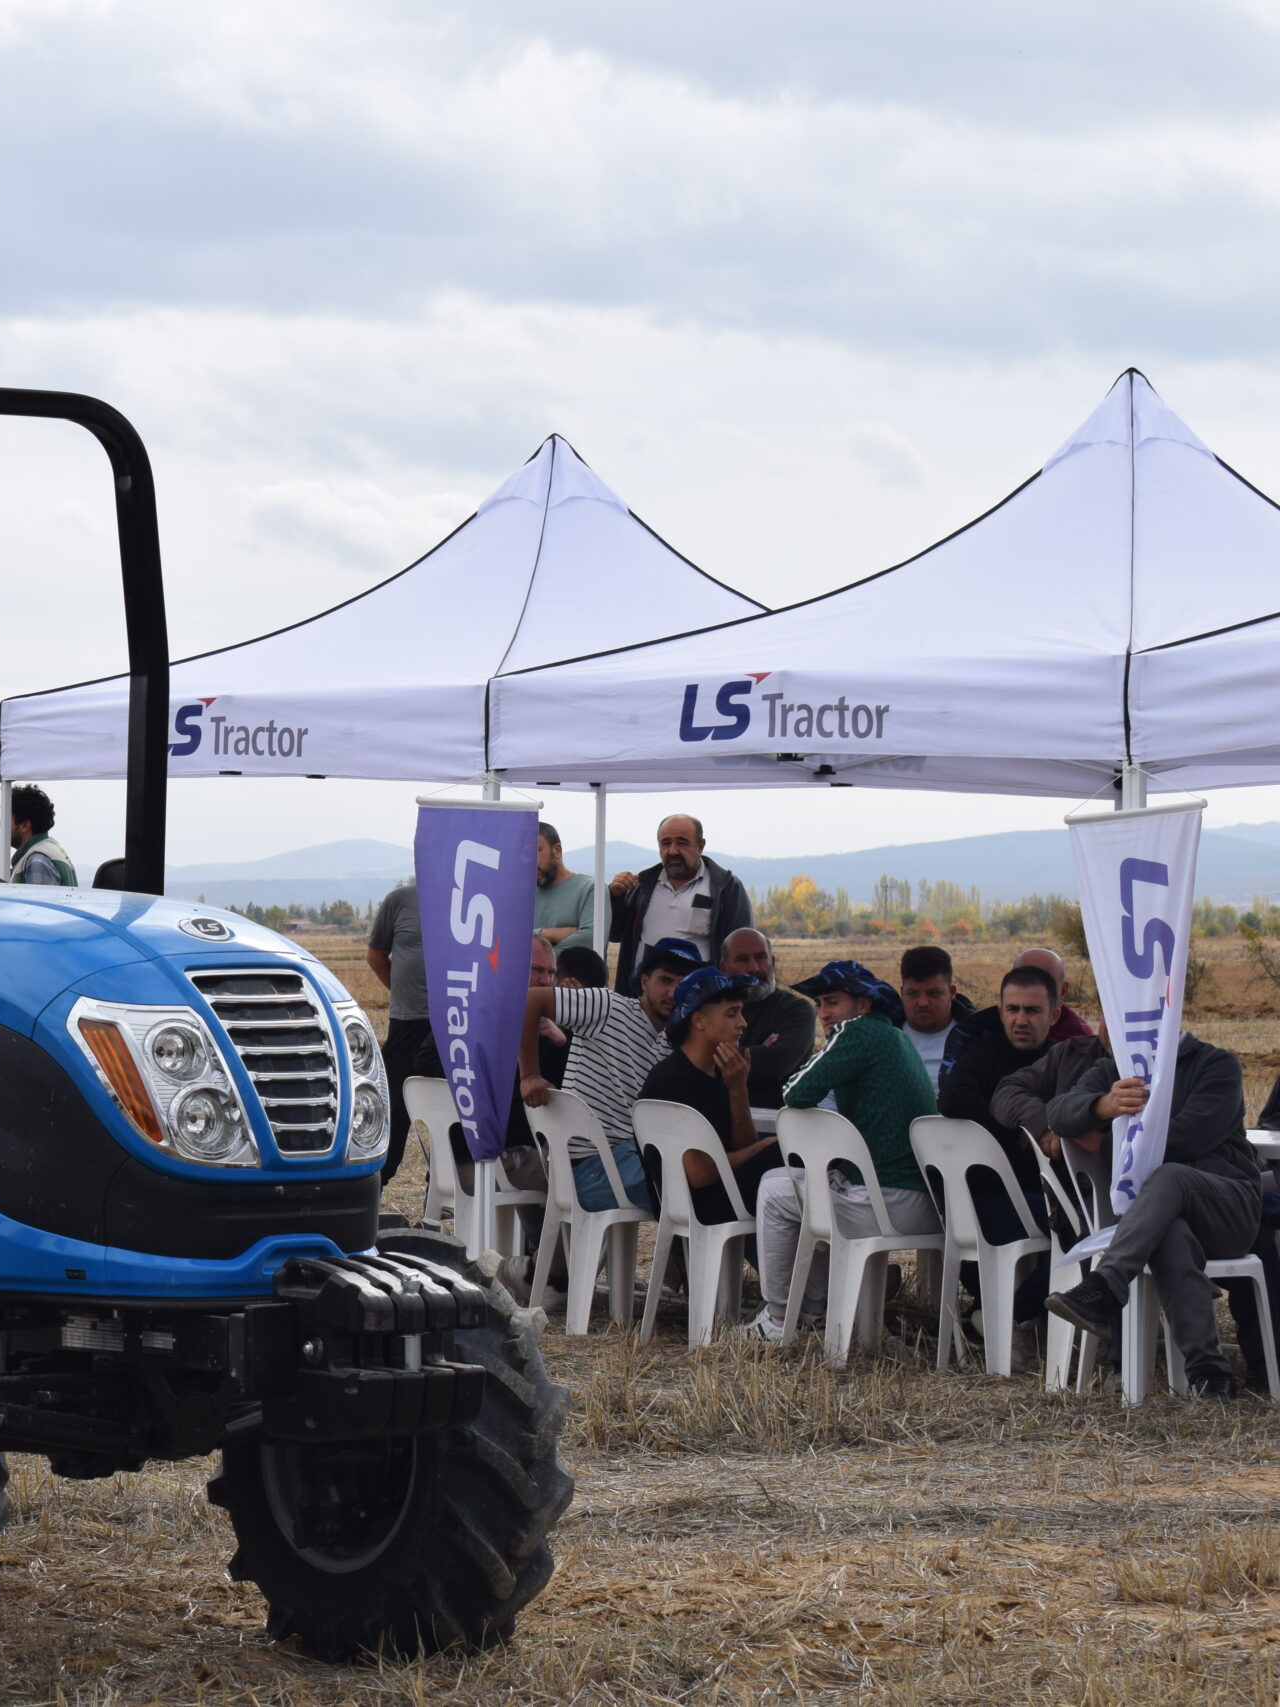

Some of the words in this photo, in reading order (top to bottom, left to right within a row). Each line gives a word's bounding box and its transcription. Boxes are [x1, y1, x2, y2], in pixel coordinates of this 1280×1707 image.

[168, 704, 204, 757] S
[209, 715, 309, 758] Tractor
[679, 680, 753, 742] LS
[761, 692, 890, 739] Tractor
[197, 922, 220, 932] LS
[449, 839, 501, 949] LS
[1119, 857, 1176, 981] LS
[446, 961, 480, 1141] Tractor
